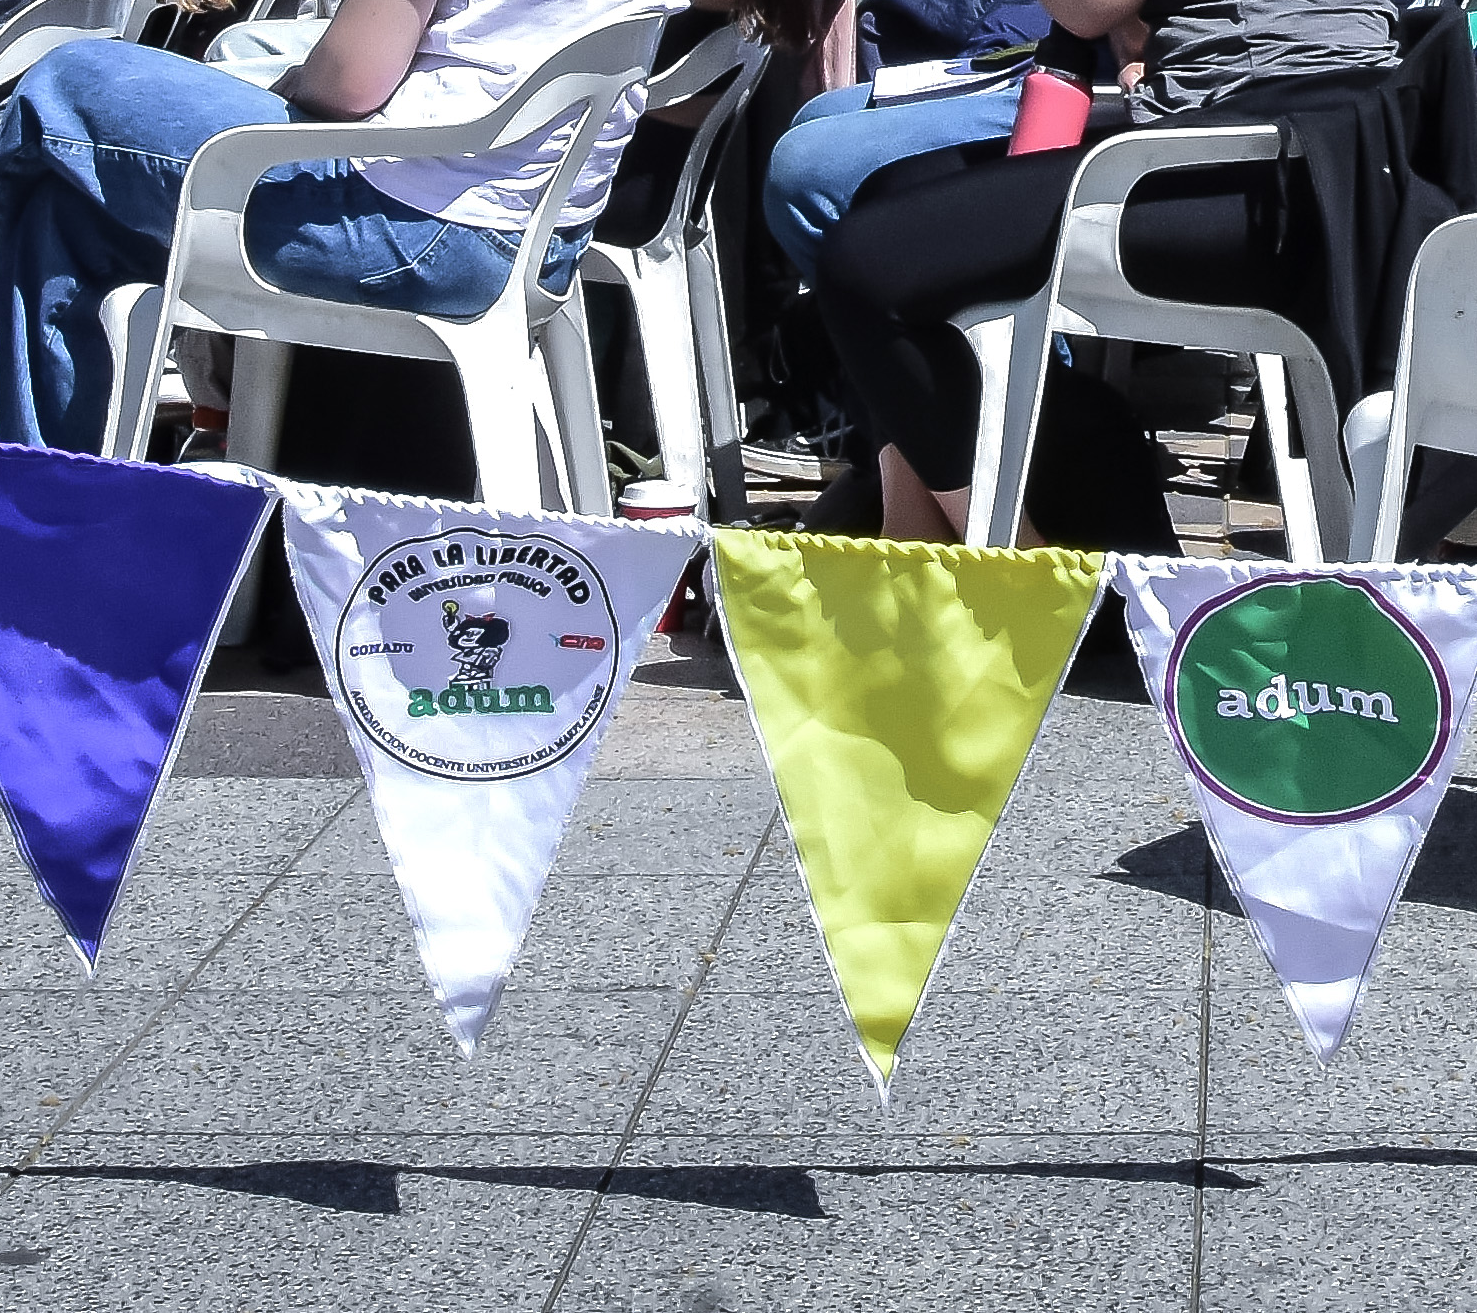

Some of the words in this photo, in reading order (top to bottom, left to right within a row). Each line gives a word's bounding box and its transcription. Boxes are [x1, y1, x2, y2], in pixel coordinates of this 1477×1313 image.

[368, 554, 427, 606] PARA
[432, 543, 465, 568] LA
[475, 545, 591, 606] LIBERTAD
[408, 684, 555, 717] adum
[1216, 673, 1400, 724] adum
[350, 689, 408, 755] AGREMIACION
[409, 749, 465, 773] DOCENTE
[466, 745, 556, 774] UNIVERSITARIA
[554, 684, 605, 752] MARPLATENSE
